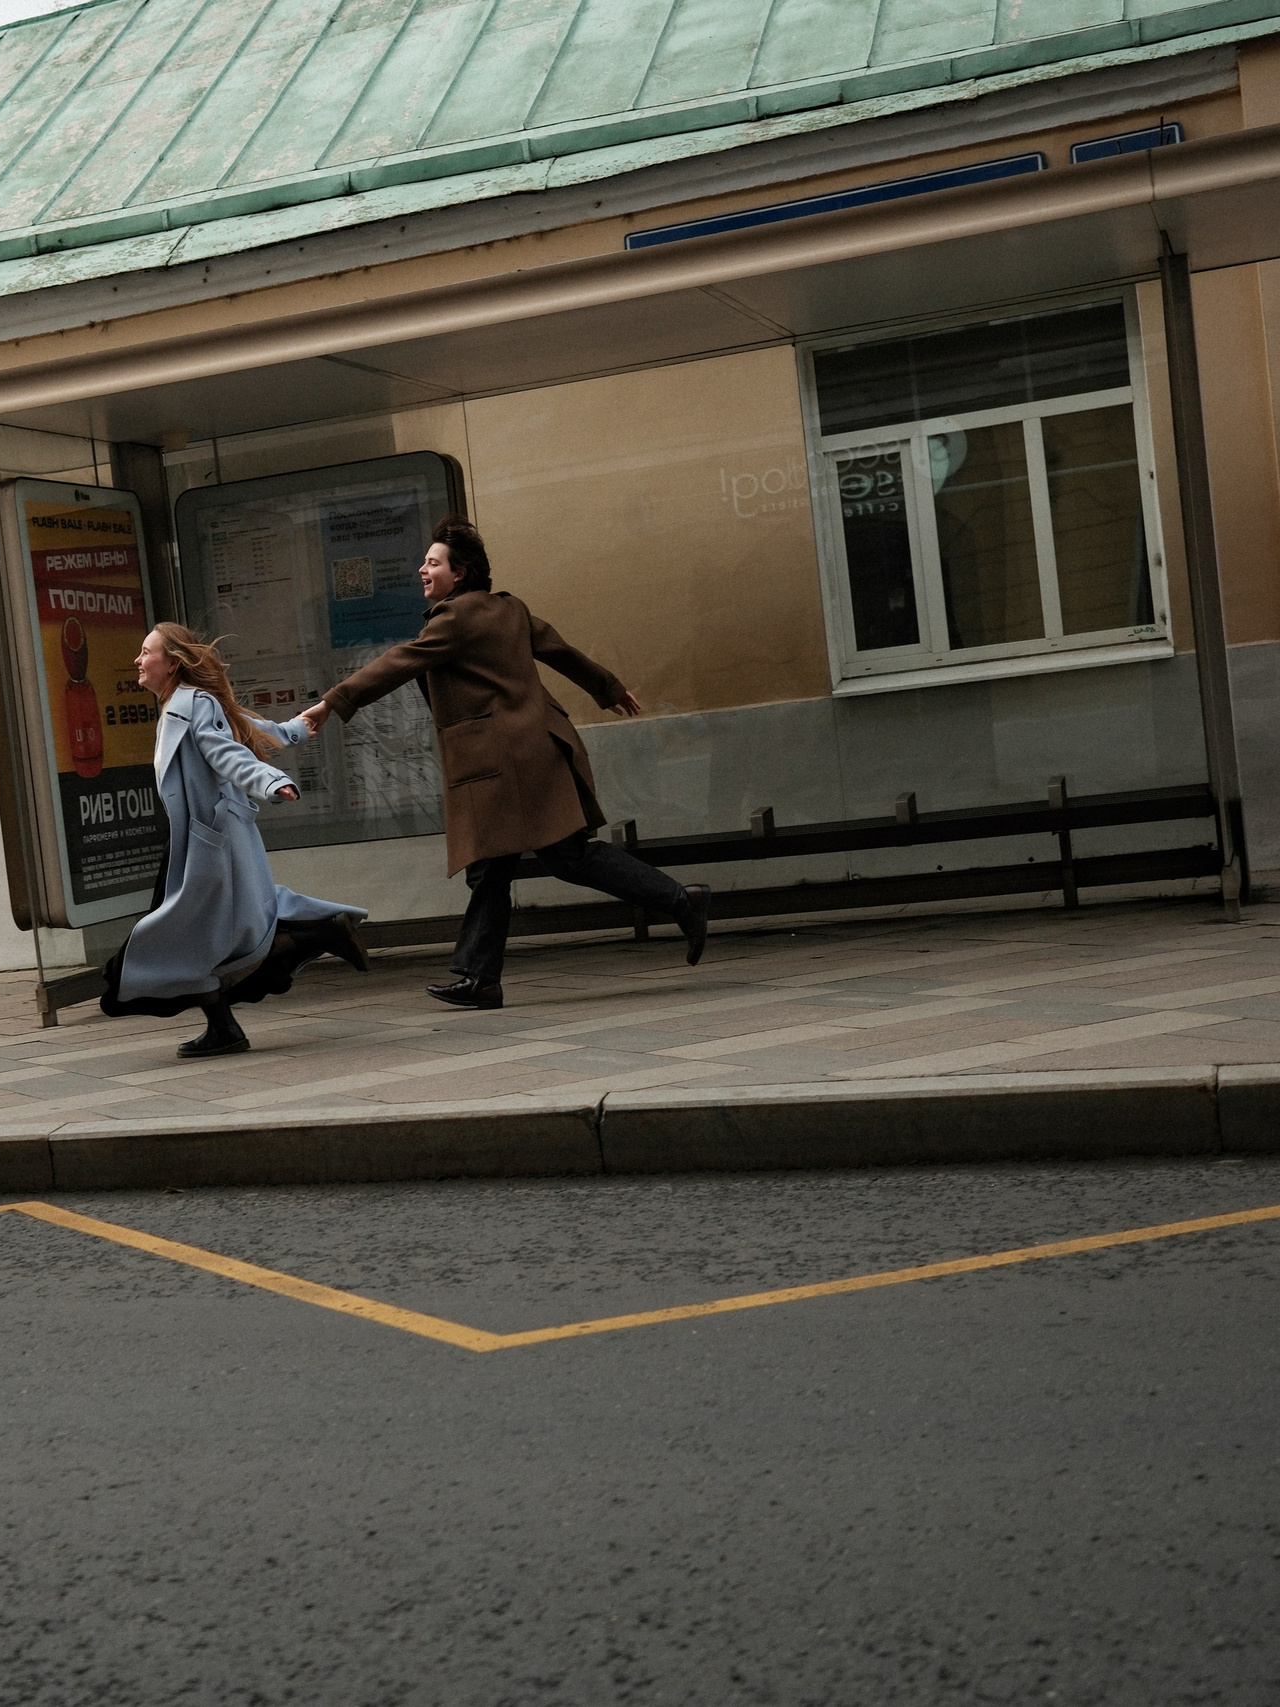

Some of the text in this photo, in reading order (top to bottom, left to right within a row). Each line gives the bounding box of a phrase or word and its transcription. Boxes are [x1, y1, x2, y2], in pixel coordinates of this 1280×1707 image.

[32, 516, 133, 534] FLASH SALE FLASH SALE
[352, 526, 405, 541] транспорт
[46, 550, 128, 571] РЕЖЕМ ЦЕНЫ
[48, 588, 134, 615] ПОПОЛАМ
[79, 787, 155, 826] РИВ ГОШ
[82, 825, 157, 844] ПАРФЮМЕРИЯ И КОСМЕТИКА
